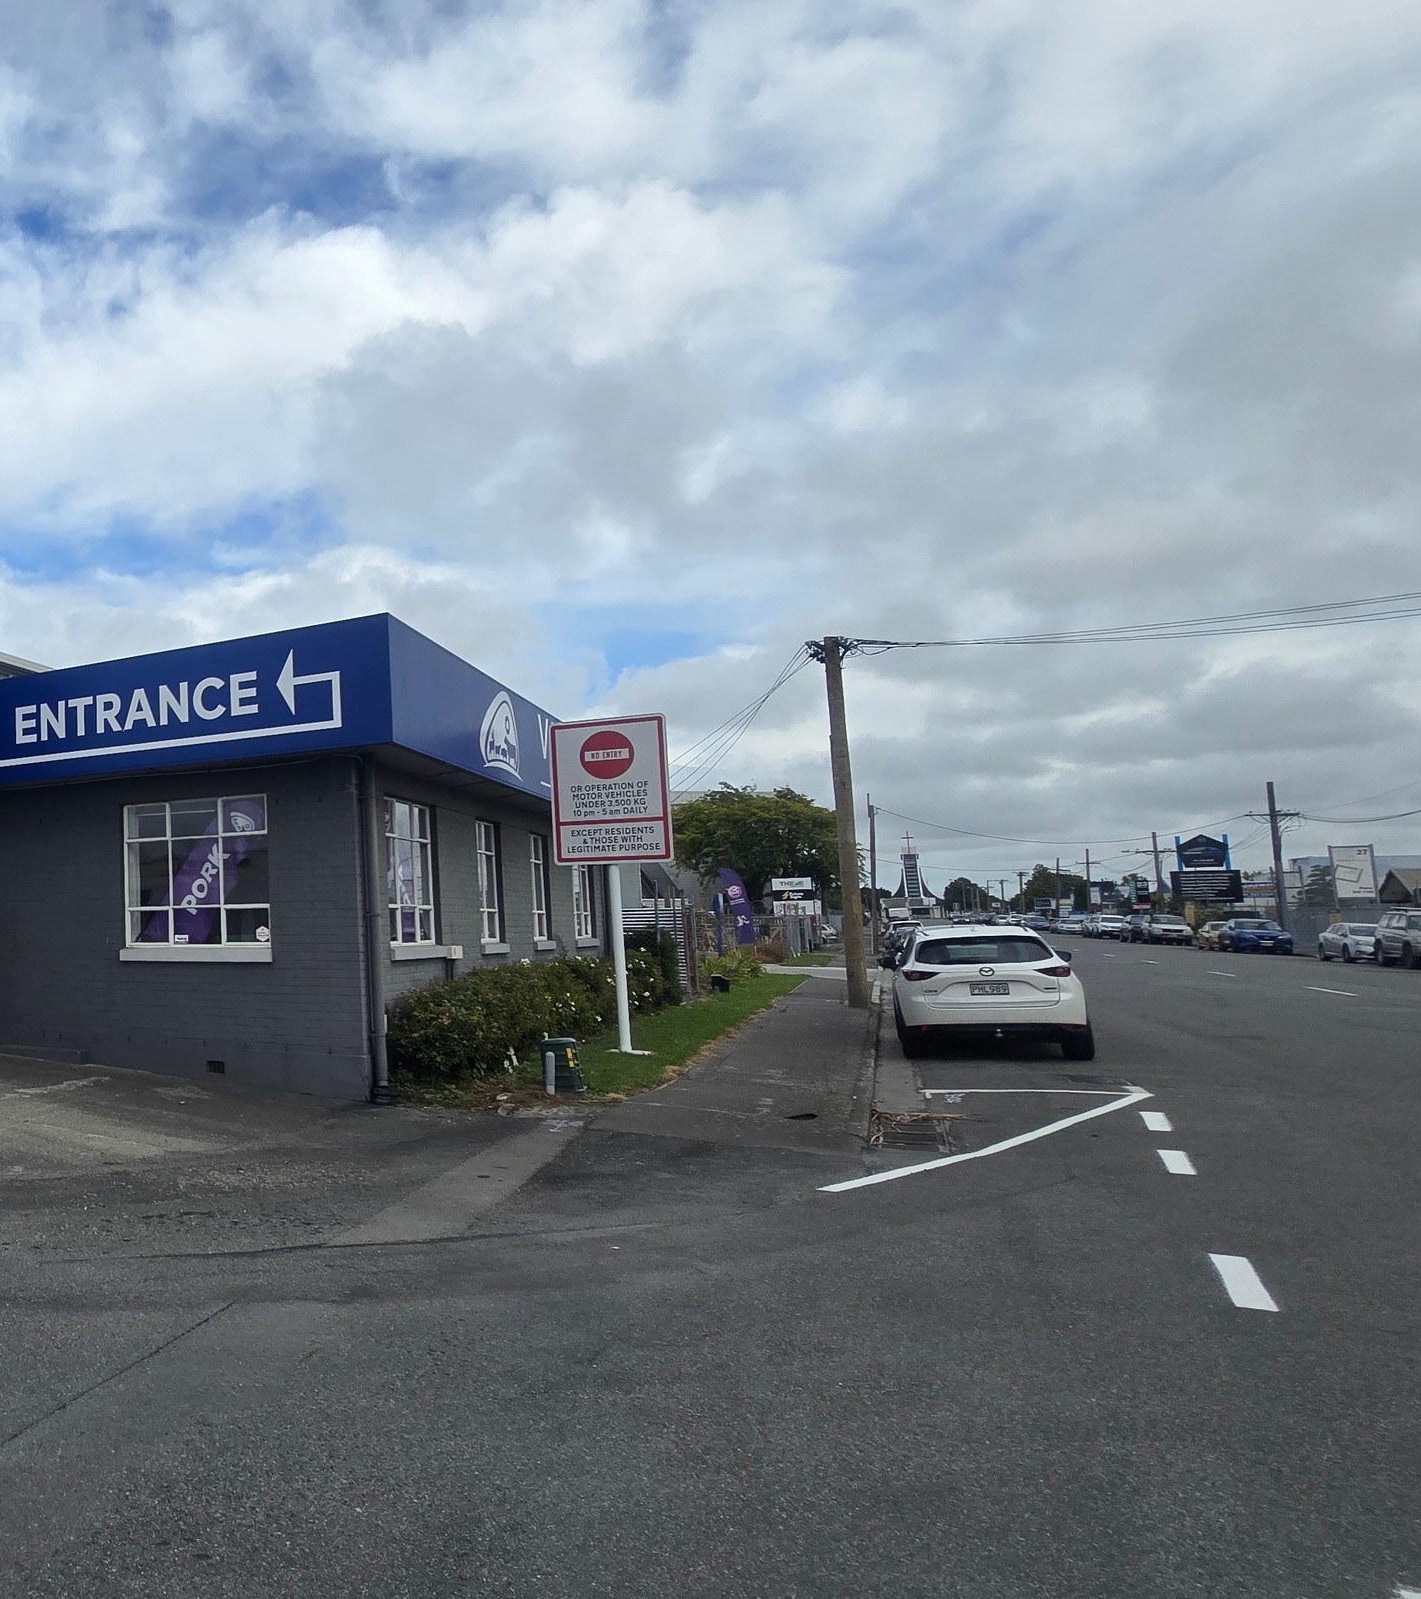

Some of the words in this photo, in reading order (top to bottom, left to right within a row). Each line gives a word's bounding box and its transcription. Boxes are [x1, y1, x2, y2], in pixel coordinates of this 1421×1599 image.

[15, 671, 259, 745] ENTRANCE
[602, 750, 623, 759] ENTRY
[570, 785, 582, 793] OR
[584, 782, 634, 792] OPERATION
[572, 792, 602, 801] MOTOR
[605, 789, 648, 799] VEHICLES
[575, 800, 606, 808] UNDER
[634, 798, 646, 806] KG
[602, 808, 607, 816] 5
[623, 806, 648, 815] DAILY
[571, 828, 602, 837] EXCEPT
[605, 826, 655, 836] RESIDENTS
[621, 834, 643, 843] WITH
[567, 844, 616, 853] LEGITIMATE
[619, 842, 661, 852] PURPOSE
[181, 843, 230, 915] PORK
[971, 984, 1007, 994] PHL989
